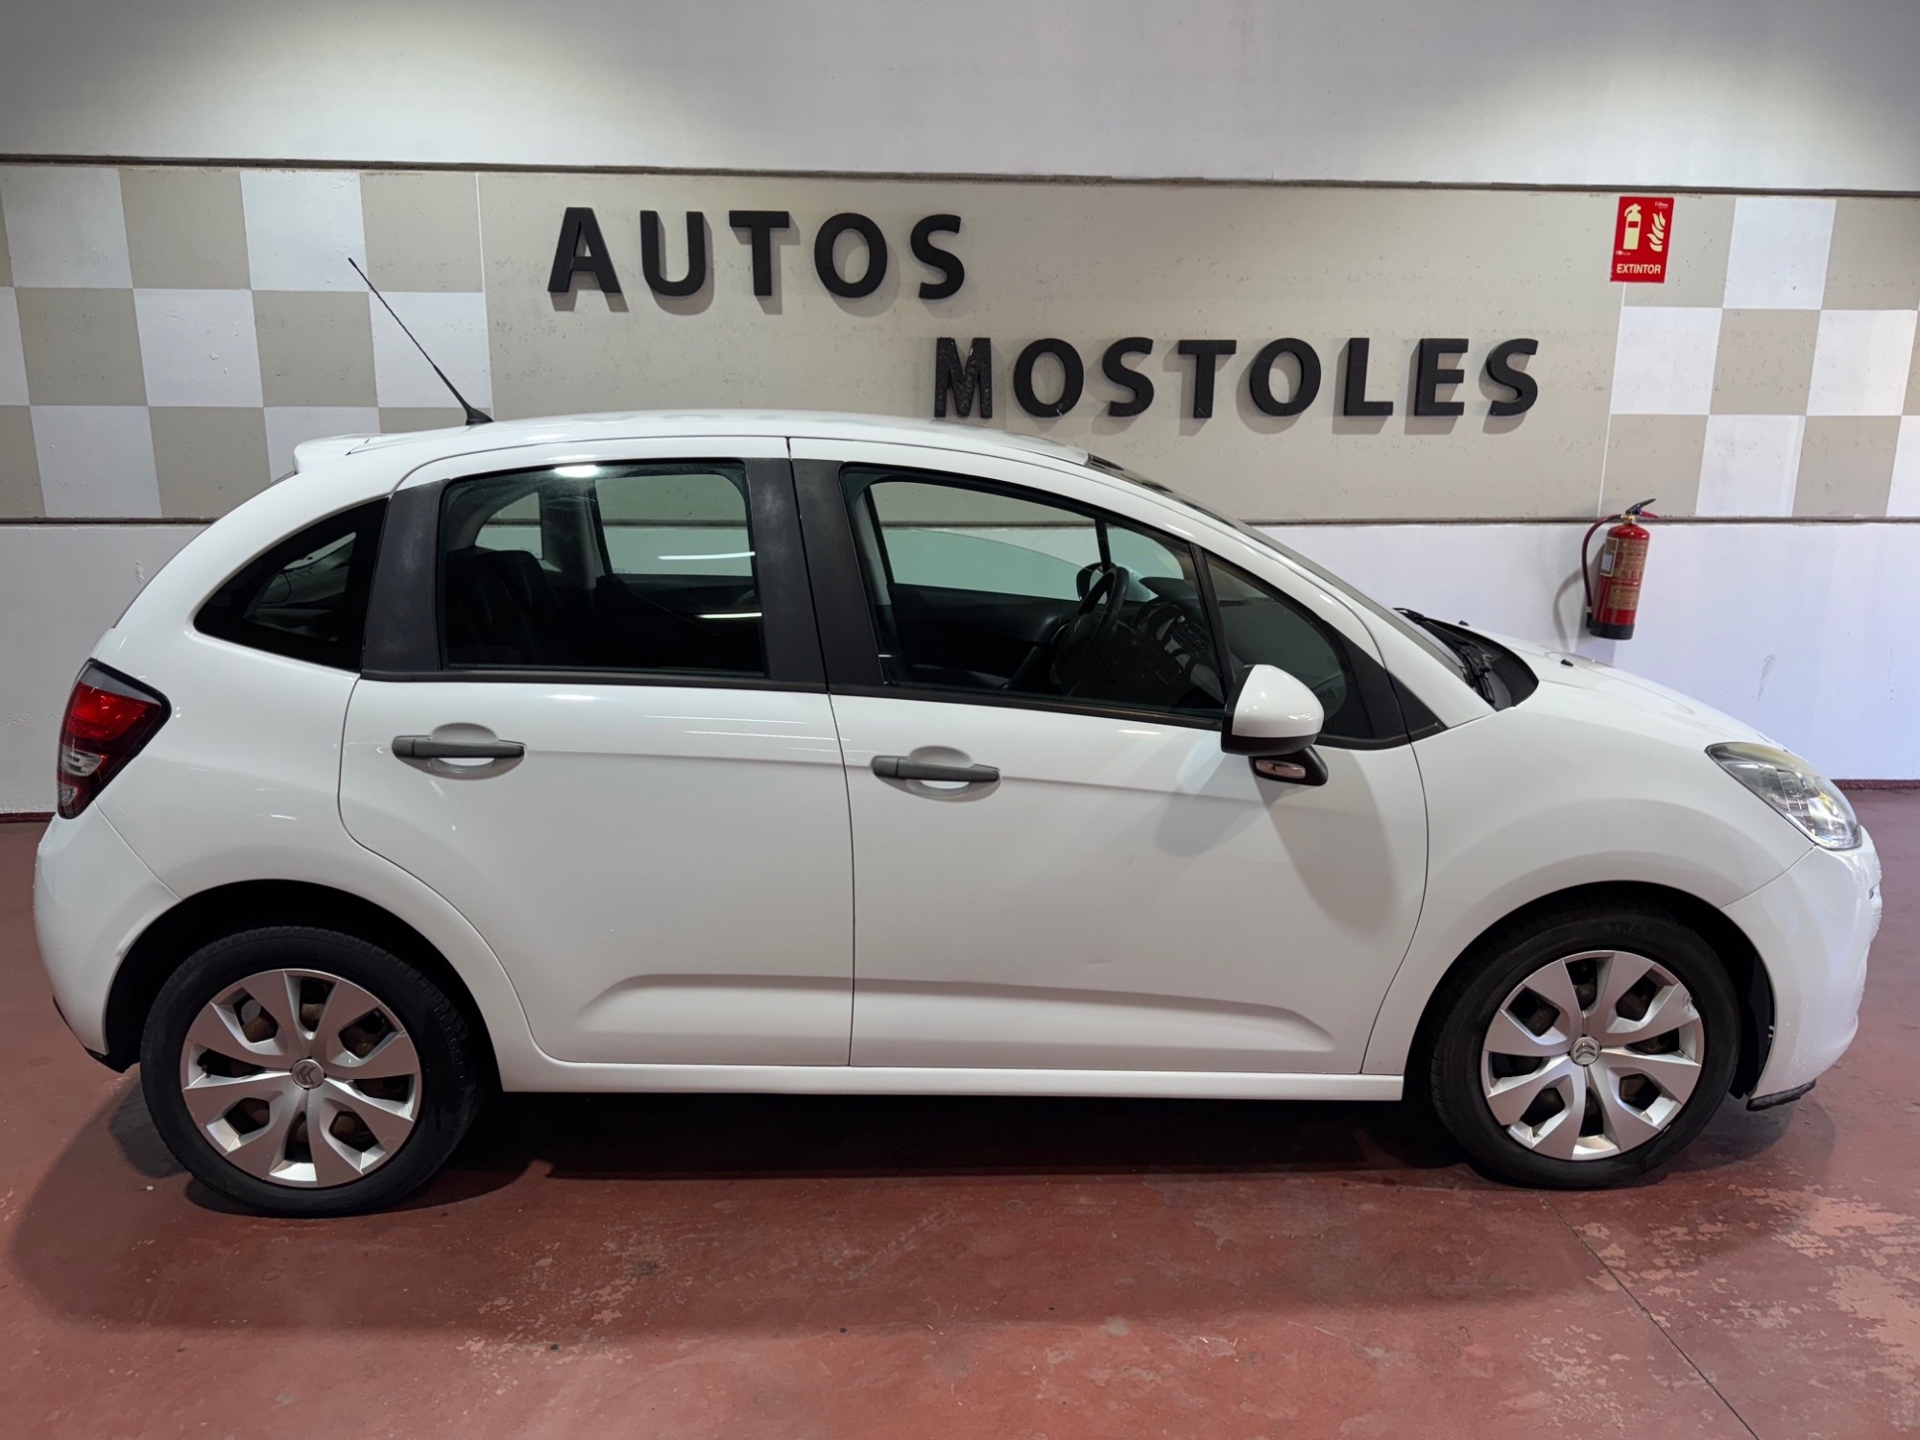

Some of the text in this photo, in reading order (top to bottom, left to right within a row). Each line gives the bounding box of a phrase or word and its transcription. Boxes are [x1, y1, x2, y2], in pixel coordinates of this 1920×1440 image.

[547, 207, 966, 300] AUTOS
[1616, 264, 1661, 274] EXTINTOR
[934, 337, 1539, 419] MOSTOLES
